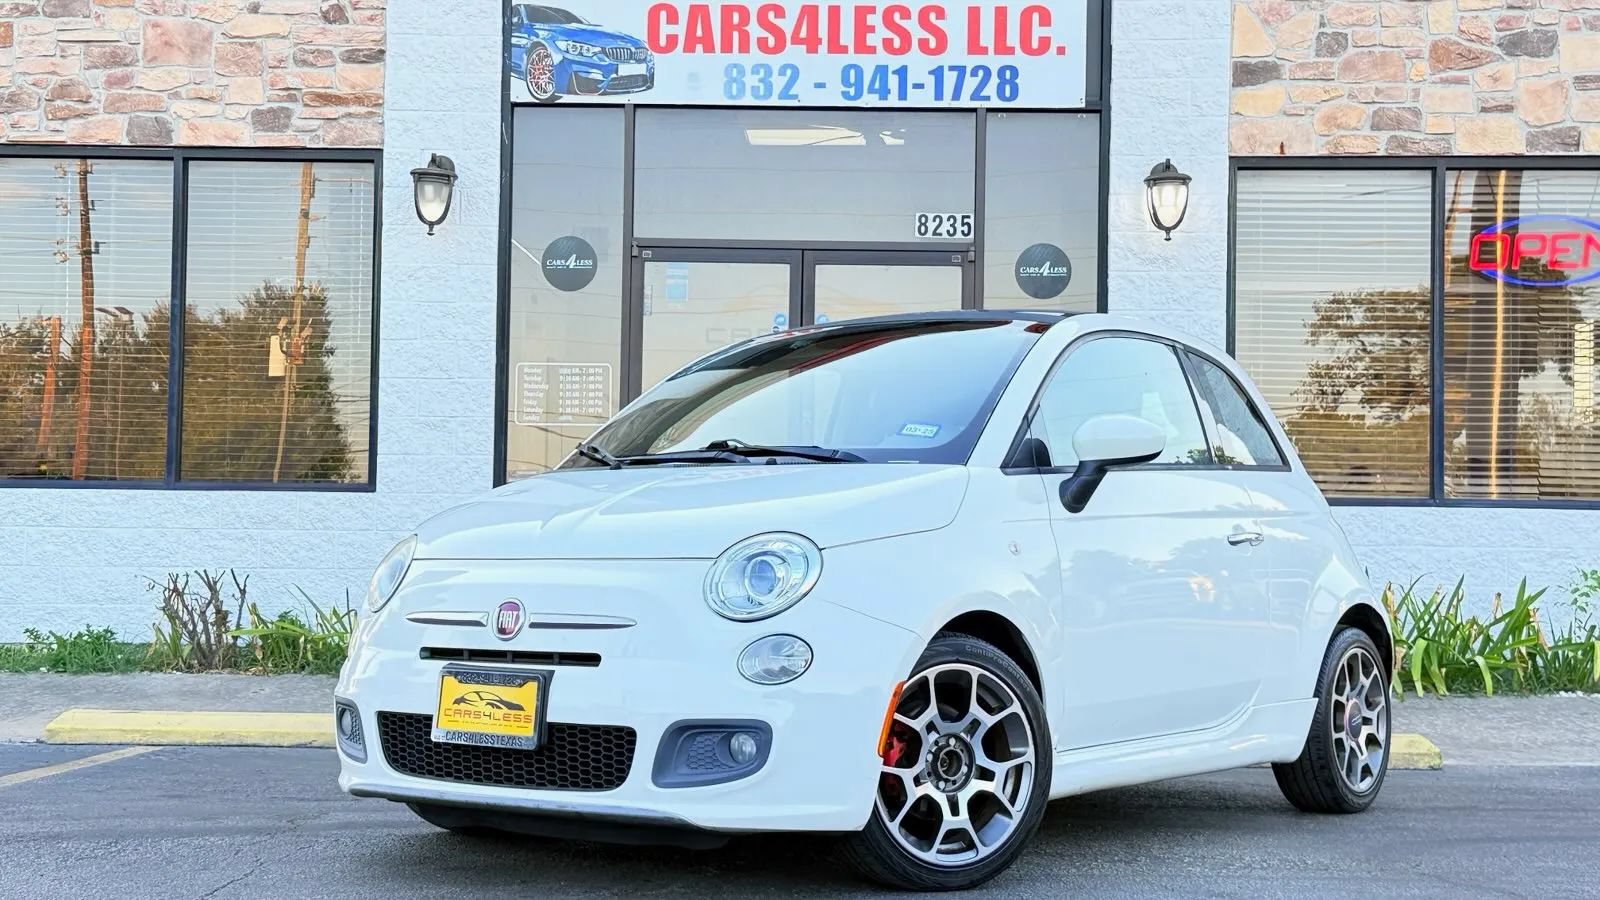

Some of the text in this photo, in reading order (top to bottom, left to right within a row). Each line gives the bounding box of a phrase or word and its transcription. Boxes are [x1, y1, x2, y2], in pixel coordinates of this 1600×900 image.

[647, 3, 1066, 56] CARS4LESS LLC.
[723, 63, 799, 100] 832
[840, 63, 1019, 102] 941-1728
[917, 213, 972, 237] 8235
[546, 253, 593, 269] CARS4LESS
[1020, 261, 1067, 276] CARS4LESS
[498, 610, 519, 629] FIAT
[443, 708, 533, 724] CARS4LESS
